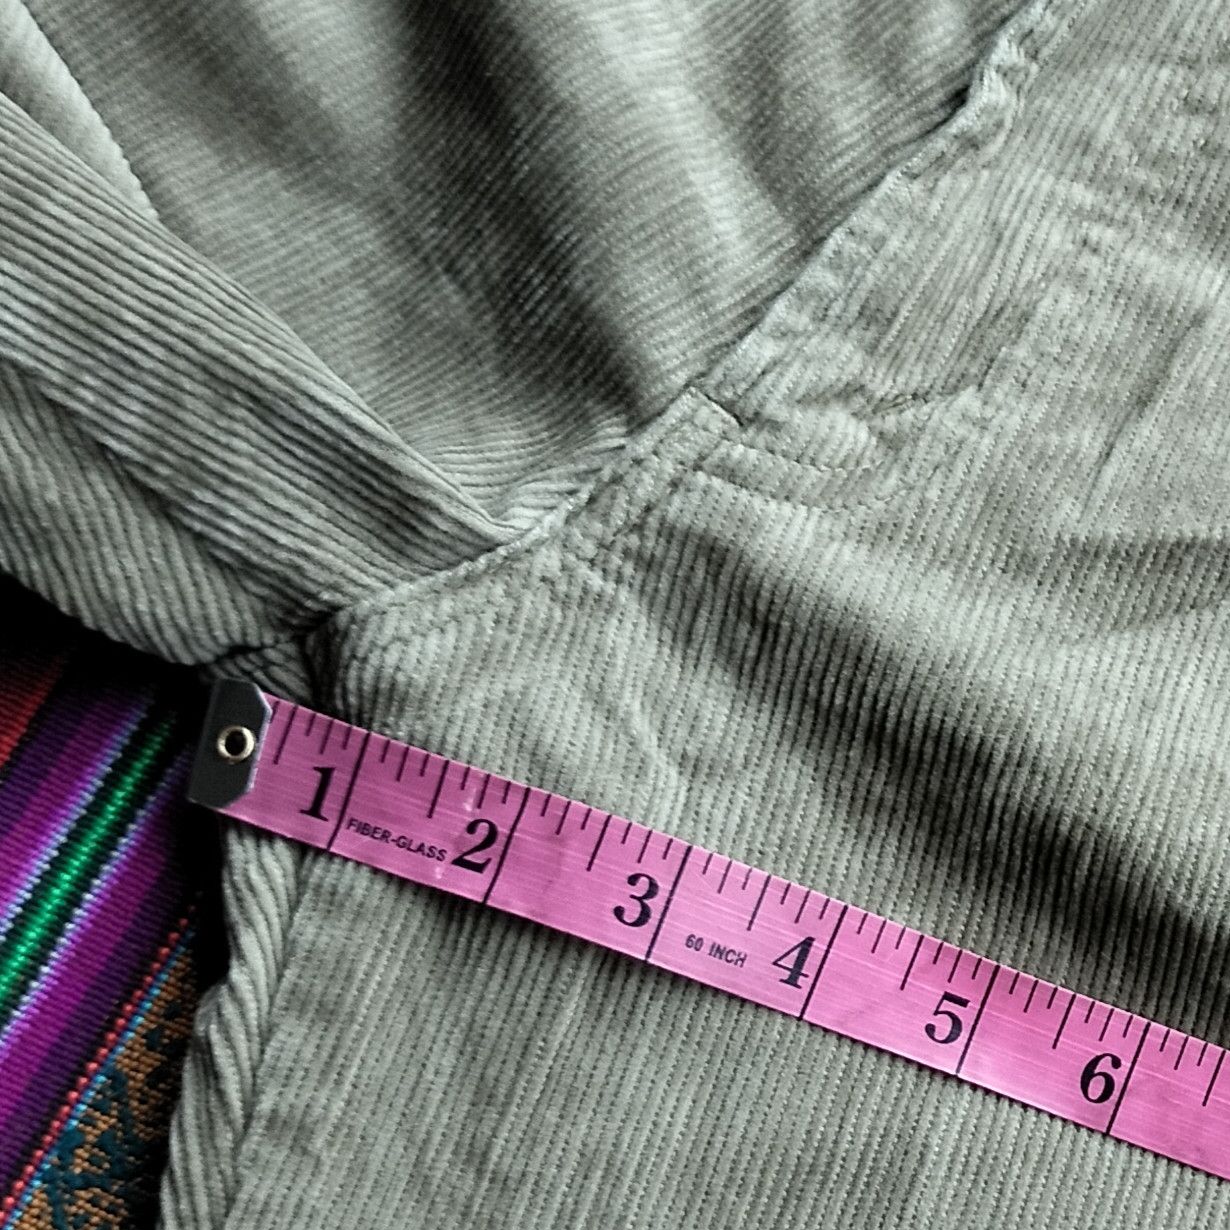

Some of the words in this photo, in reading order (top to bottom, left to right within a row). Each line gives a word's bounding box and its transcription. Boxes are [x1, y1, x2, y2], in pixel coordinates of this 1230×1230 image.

[346, 817, 448, 862] FIBER-GLASS
[299, 766, 335, 822] 1
[451, 818, 499, 873] 2
[612, 873, 660, 927] 3
[772, 936, 816, 989] 4
[924, 991, 971, 1044] 5
[1079, 1052, 1122, 1103] 6
[684, 934, 704, 953] 60
[709, 941, 748, 968] INCH
